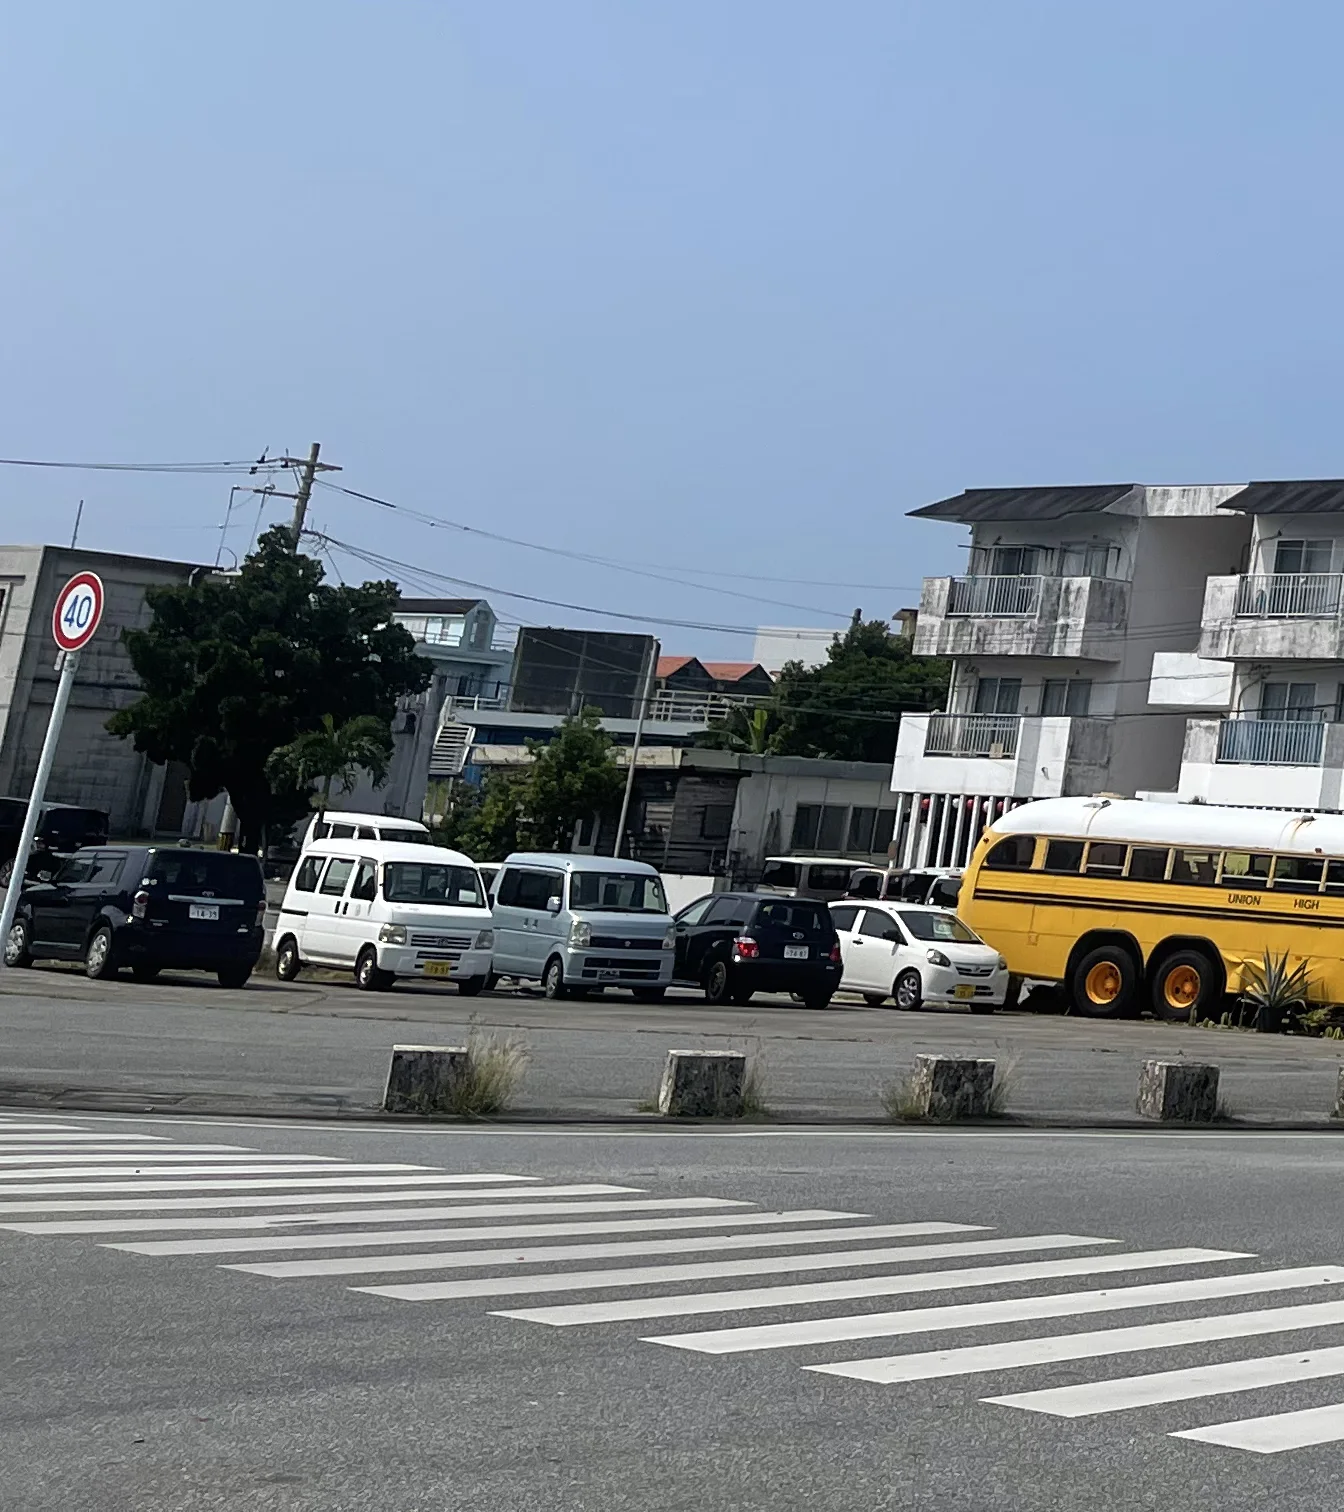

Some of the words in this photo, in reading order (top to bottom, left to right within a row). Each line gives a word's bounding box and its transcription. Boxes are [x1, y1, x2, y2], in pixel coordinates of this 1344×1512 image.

[63, 594, 93, 628] 40
[1227, 893, 1262, 906] UNION
[1293, 898, 1320, 910] HIGH
